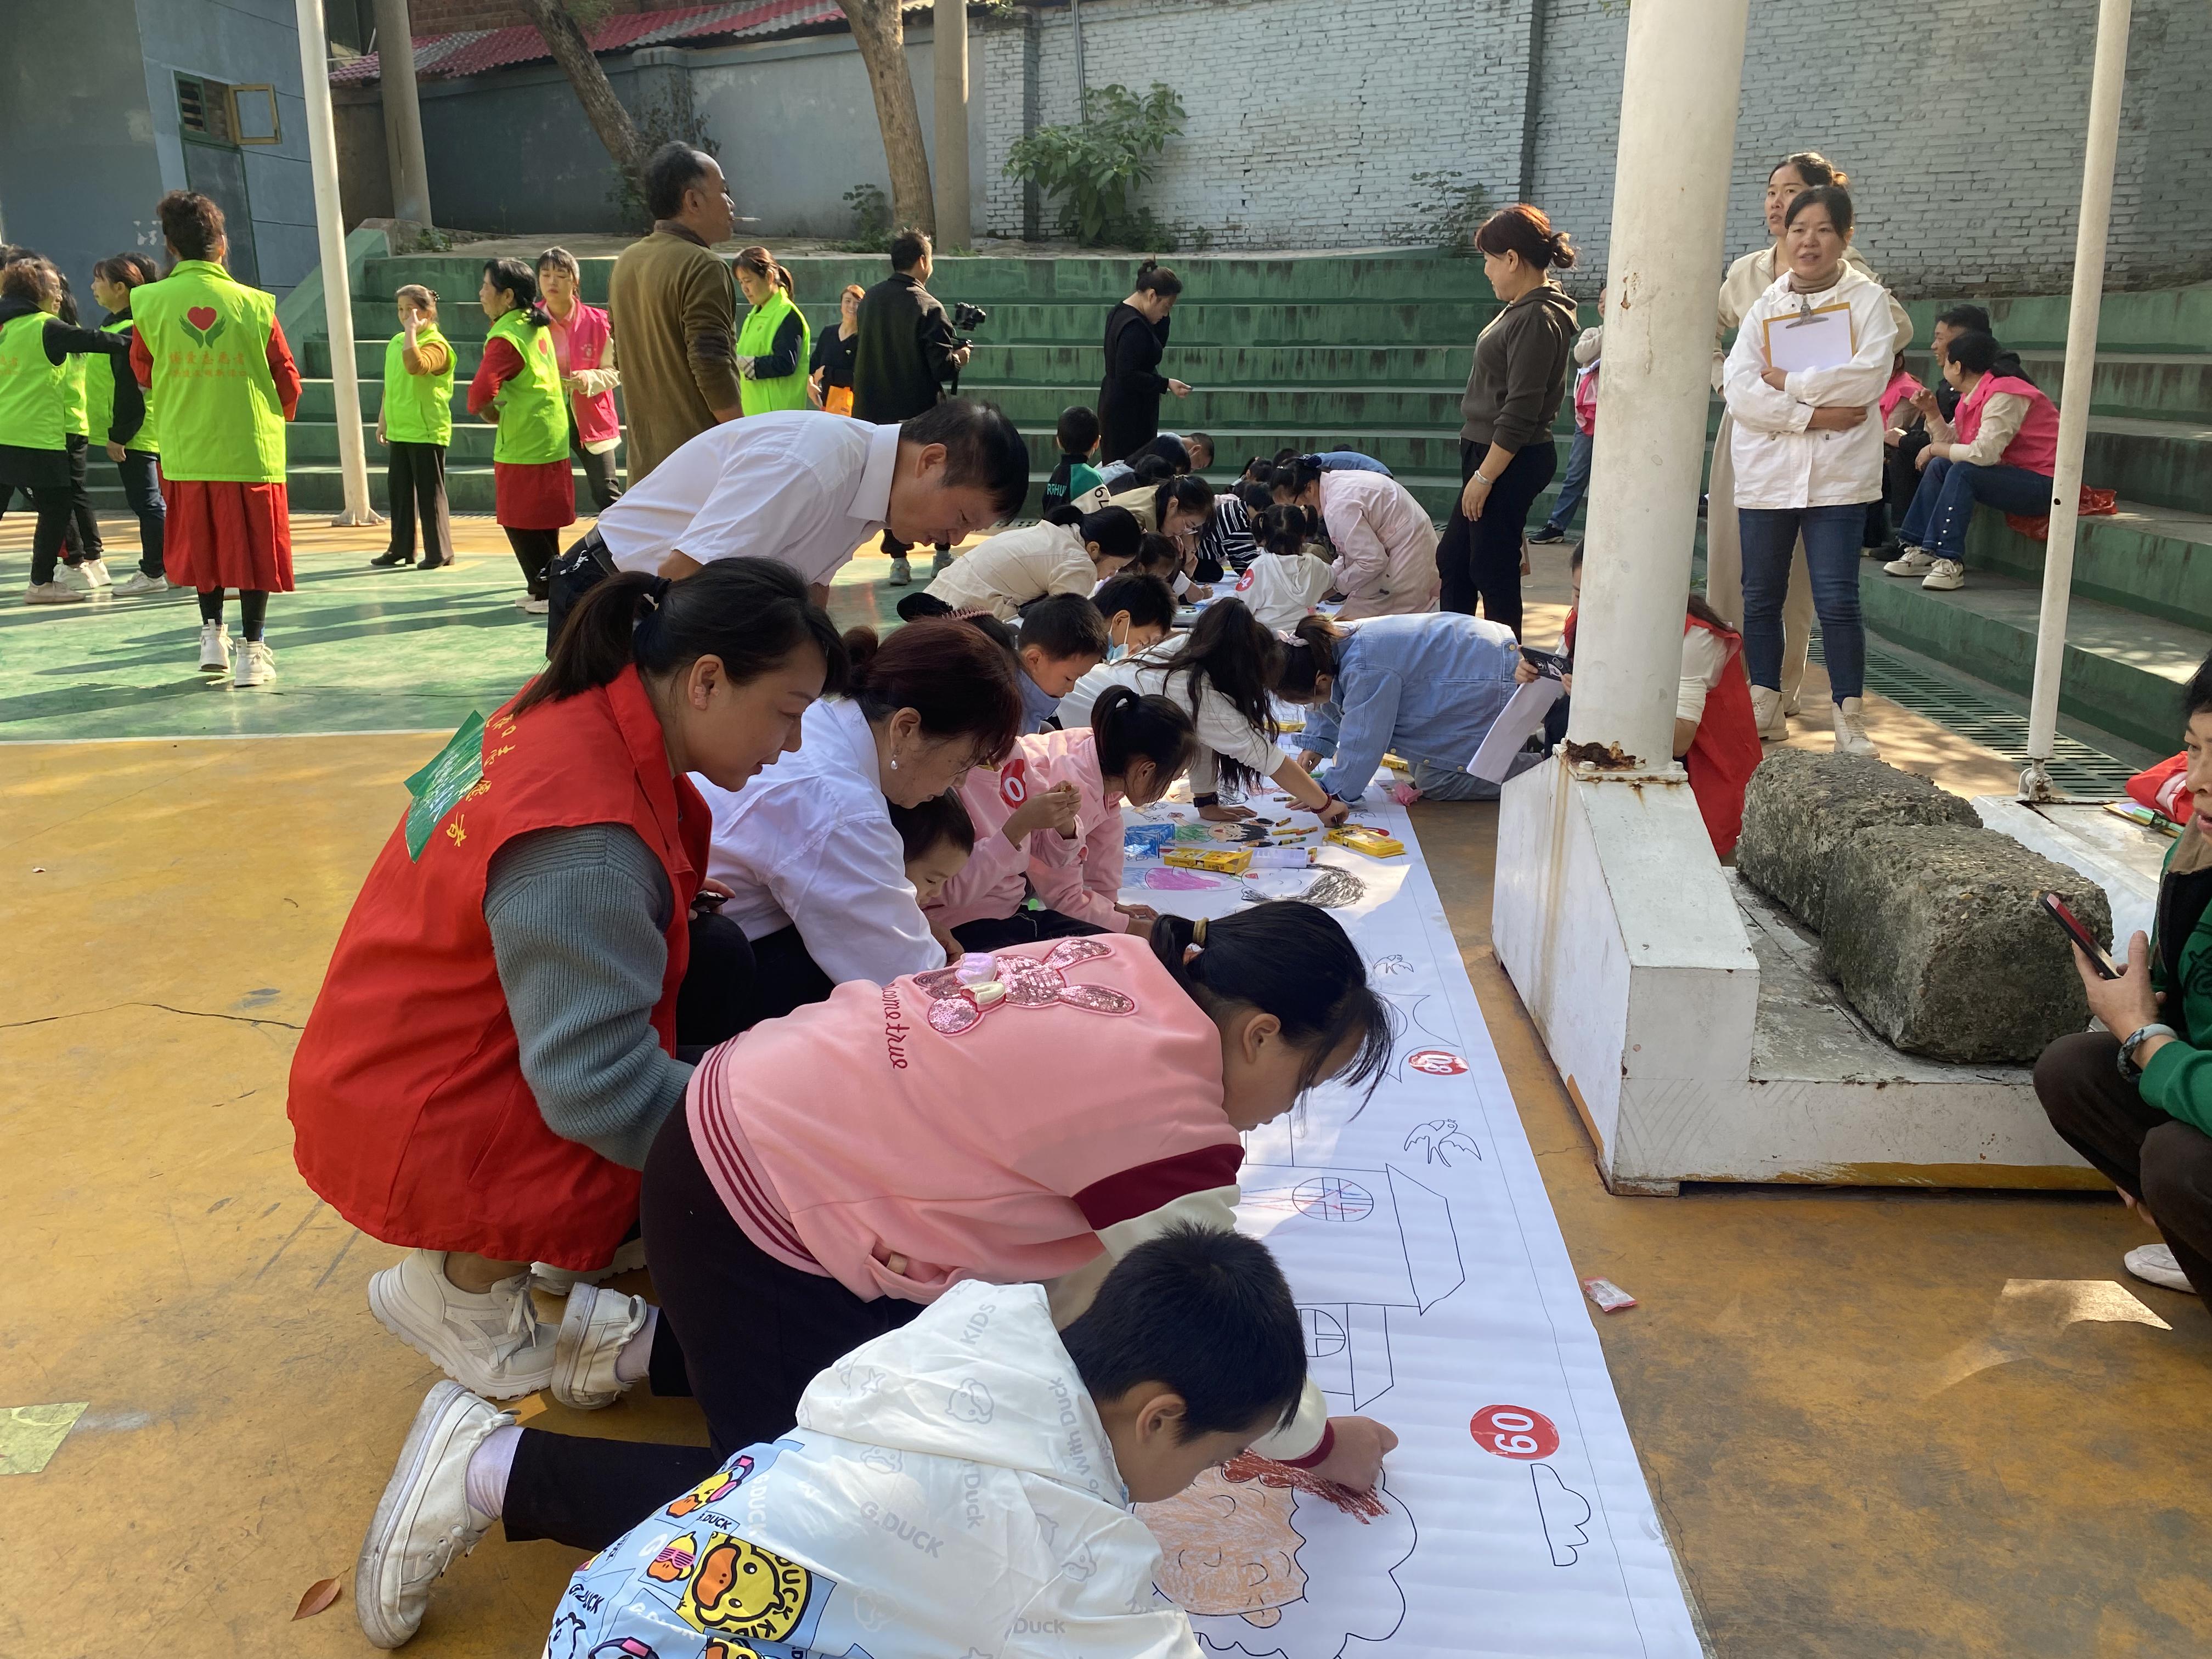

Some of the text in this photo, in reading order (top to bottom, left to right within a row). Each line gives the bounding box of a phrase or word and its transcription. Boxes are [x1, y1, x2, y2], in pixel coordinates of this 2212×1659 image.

[885, 1022, 911, 1069] true
[960, 1304, 997, 1345] KIDS
[1048, 1376, 1077, 1426] Duck
[1066, 1430, 1091, 1476] With
[1491, 1412, 1538, 1454] 09
[748, 1474, 770, 1537] G.DUCK
[964, 1474, 986, 1529] Duck
[860, 1501, 944, 1559] G.DUCK
[1014, 1617, 1066, 1634] Duck
